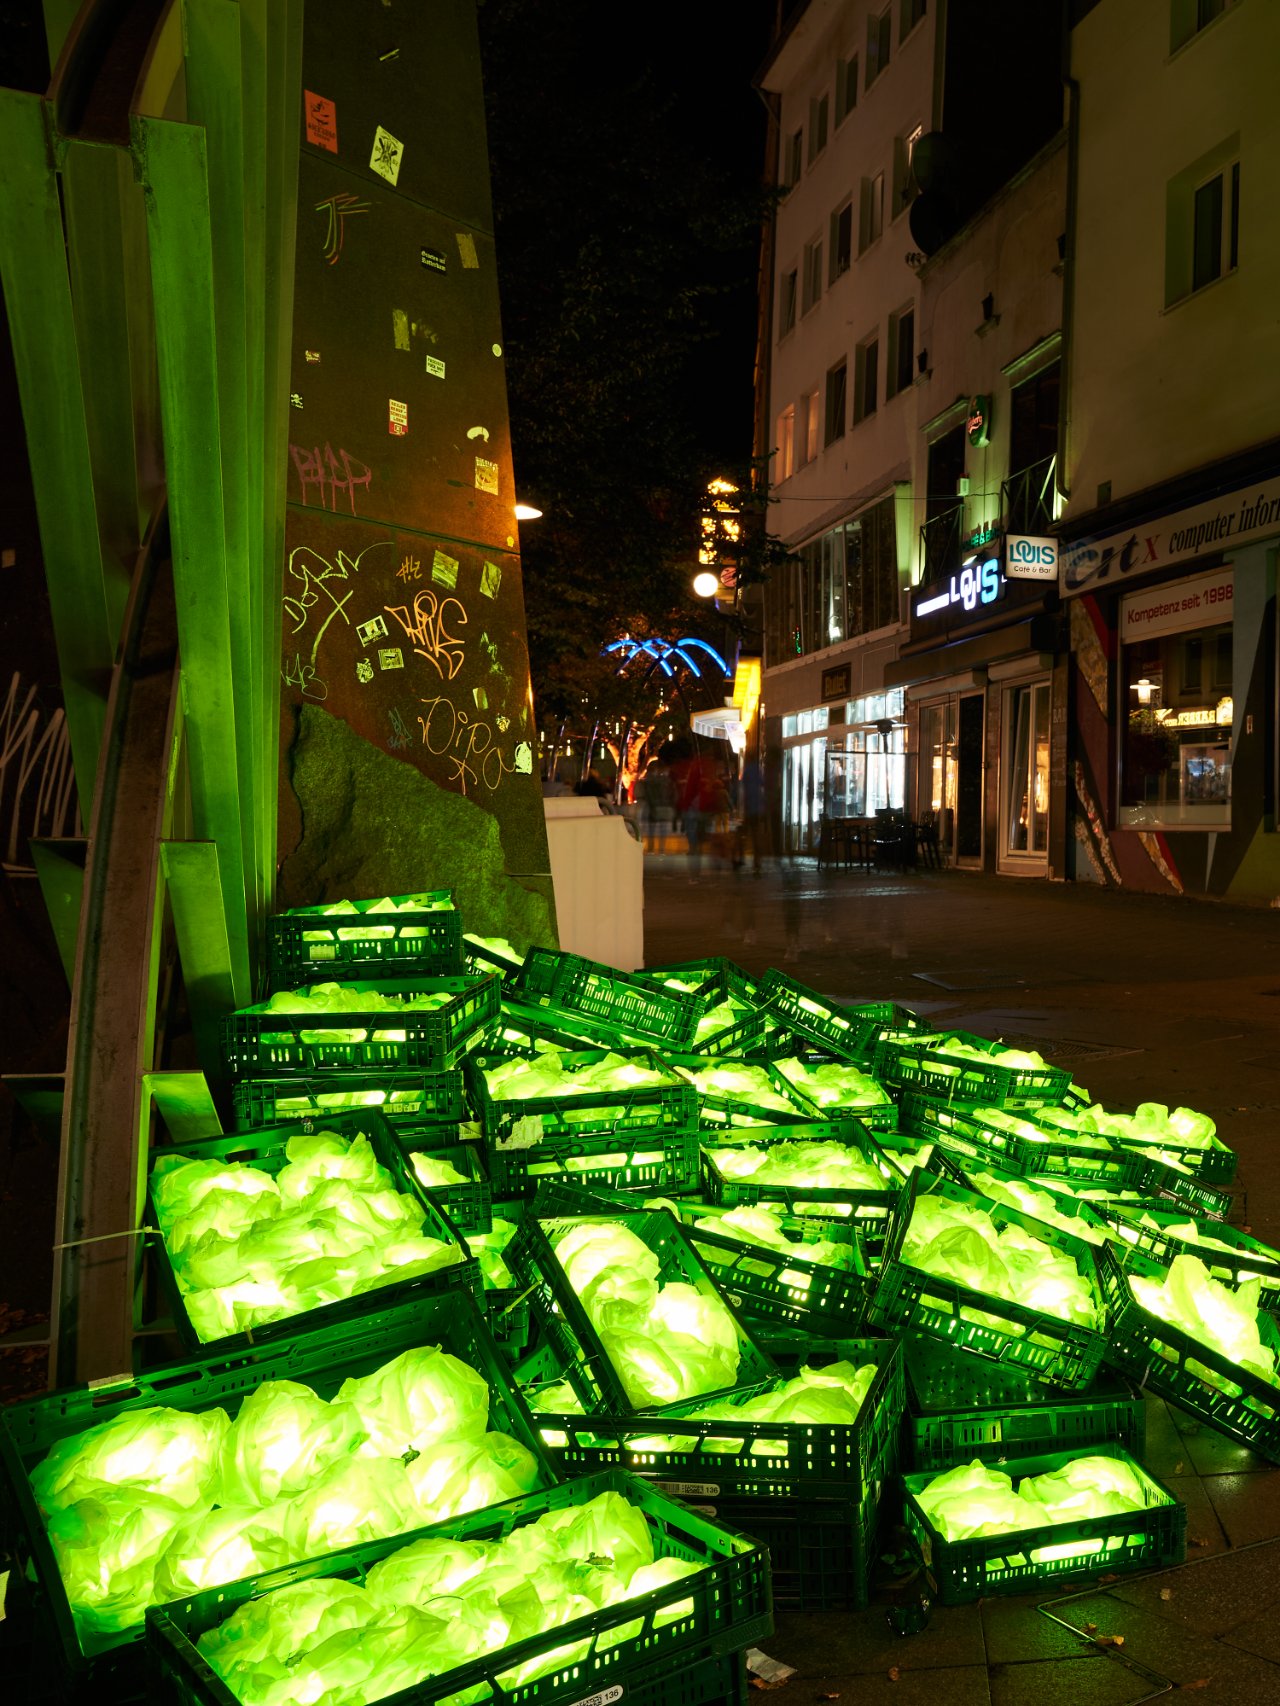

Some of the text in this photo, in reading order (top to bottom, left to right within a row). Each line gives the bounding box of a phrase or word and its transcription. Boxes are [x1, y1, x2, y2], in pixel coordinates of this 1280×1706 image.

[1009, 540, 1055, 565] LOUIS
[1038, 566, 1052, 574] Bar
[950, 558, 998, 611] LOUIS
[1127, 584, 1233, 625] Kompetenz seit 1998
[604, 1688, 619, 1700] 136
